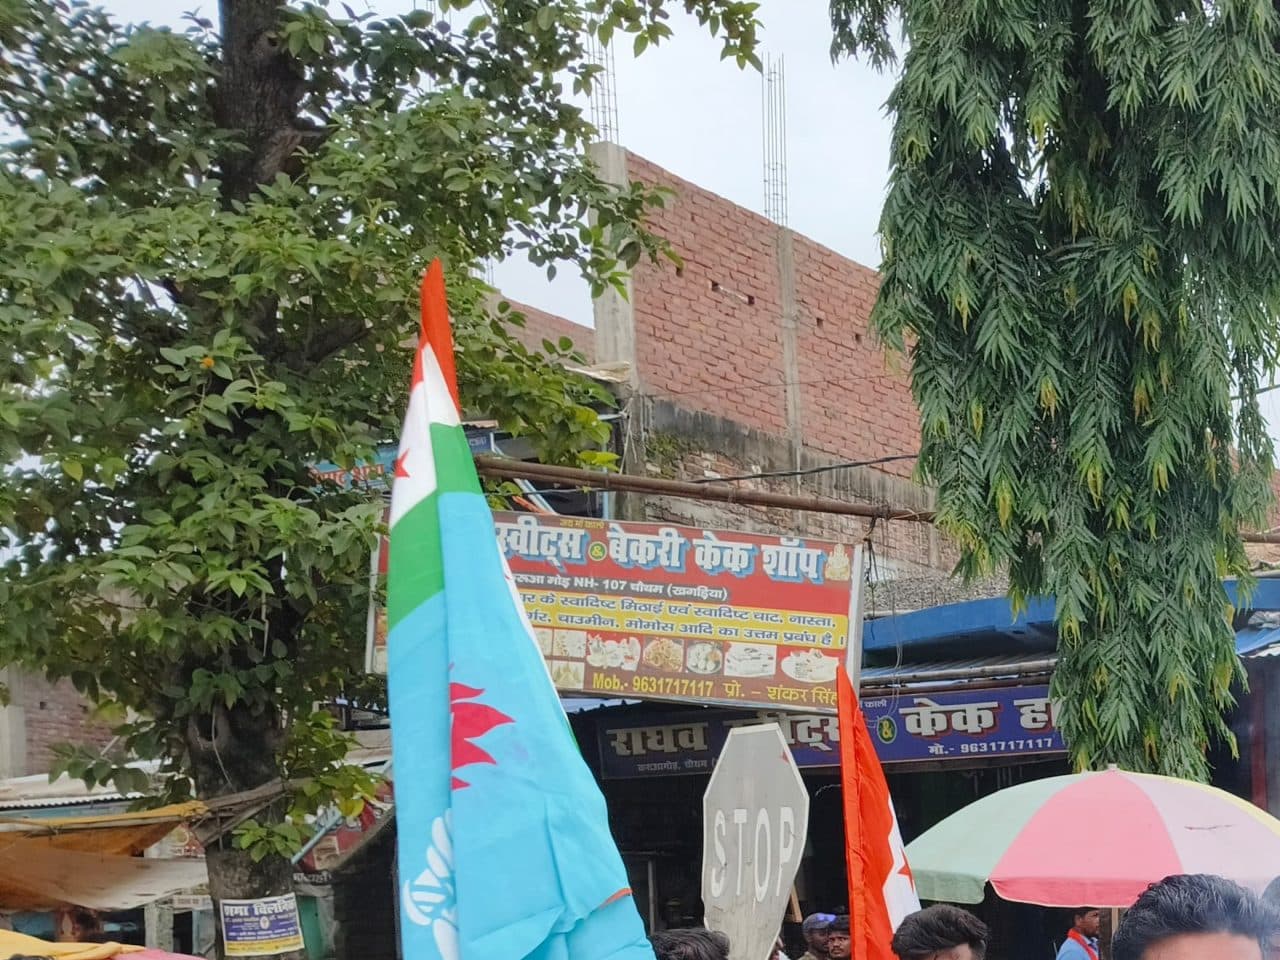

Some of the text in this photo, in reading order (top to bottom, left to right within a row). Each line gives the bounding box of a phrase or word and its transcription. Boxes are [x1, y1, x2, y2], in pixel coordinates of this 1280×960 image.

[591, 544, 604, 558] &
[606, 522, 688, 570] बेकरी
[692, 530, 755, 574] केक
[760, 537, 824, 580] शॉप
[603, 579, 626, 591] 107
[620, 597, 664, 615] मिठाई
[625, 618, 674, 632] मोमोस
[679, 621, 713, 634] आदि
[718, 626, 738, 637] का
[743, 628, 778, 639] उत्तम
[632, 675, 714, 697] 9631717117
[767, 684, 809, 701] शंकर
[880, 717, 893, 739] &
[899, 697, 999, 737] केक
[960, 737, 1053, 754] 9631717117
[711, 806, 795, 902] STOP
